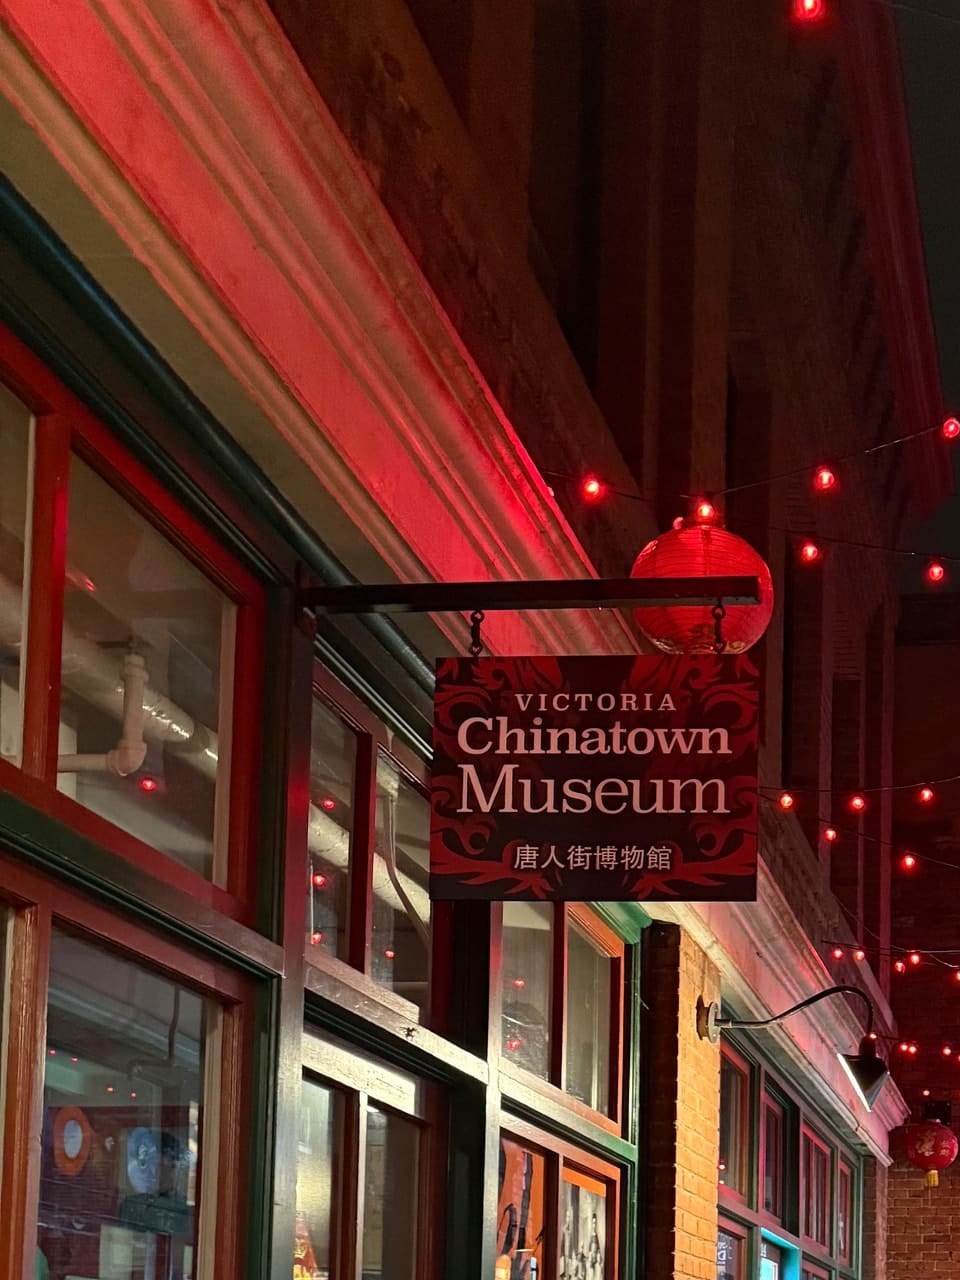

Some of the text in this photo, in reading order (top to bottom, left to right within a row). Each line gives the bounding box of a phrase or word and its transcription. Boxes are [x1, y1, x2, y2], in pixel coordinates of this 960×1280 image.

[514, 693, 677, 711] VICTORIA
[457, 716, 732, 754] Chinatown
[456, 764, 731, 813] Museum
[513, 845, 672, 870] 唐人街博物館
